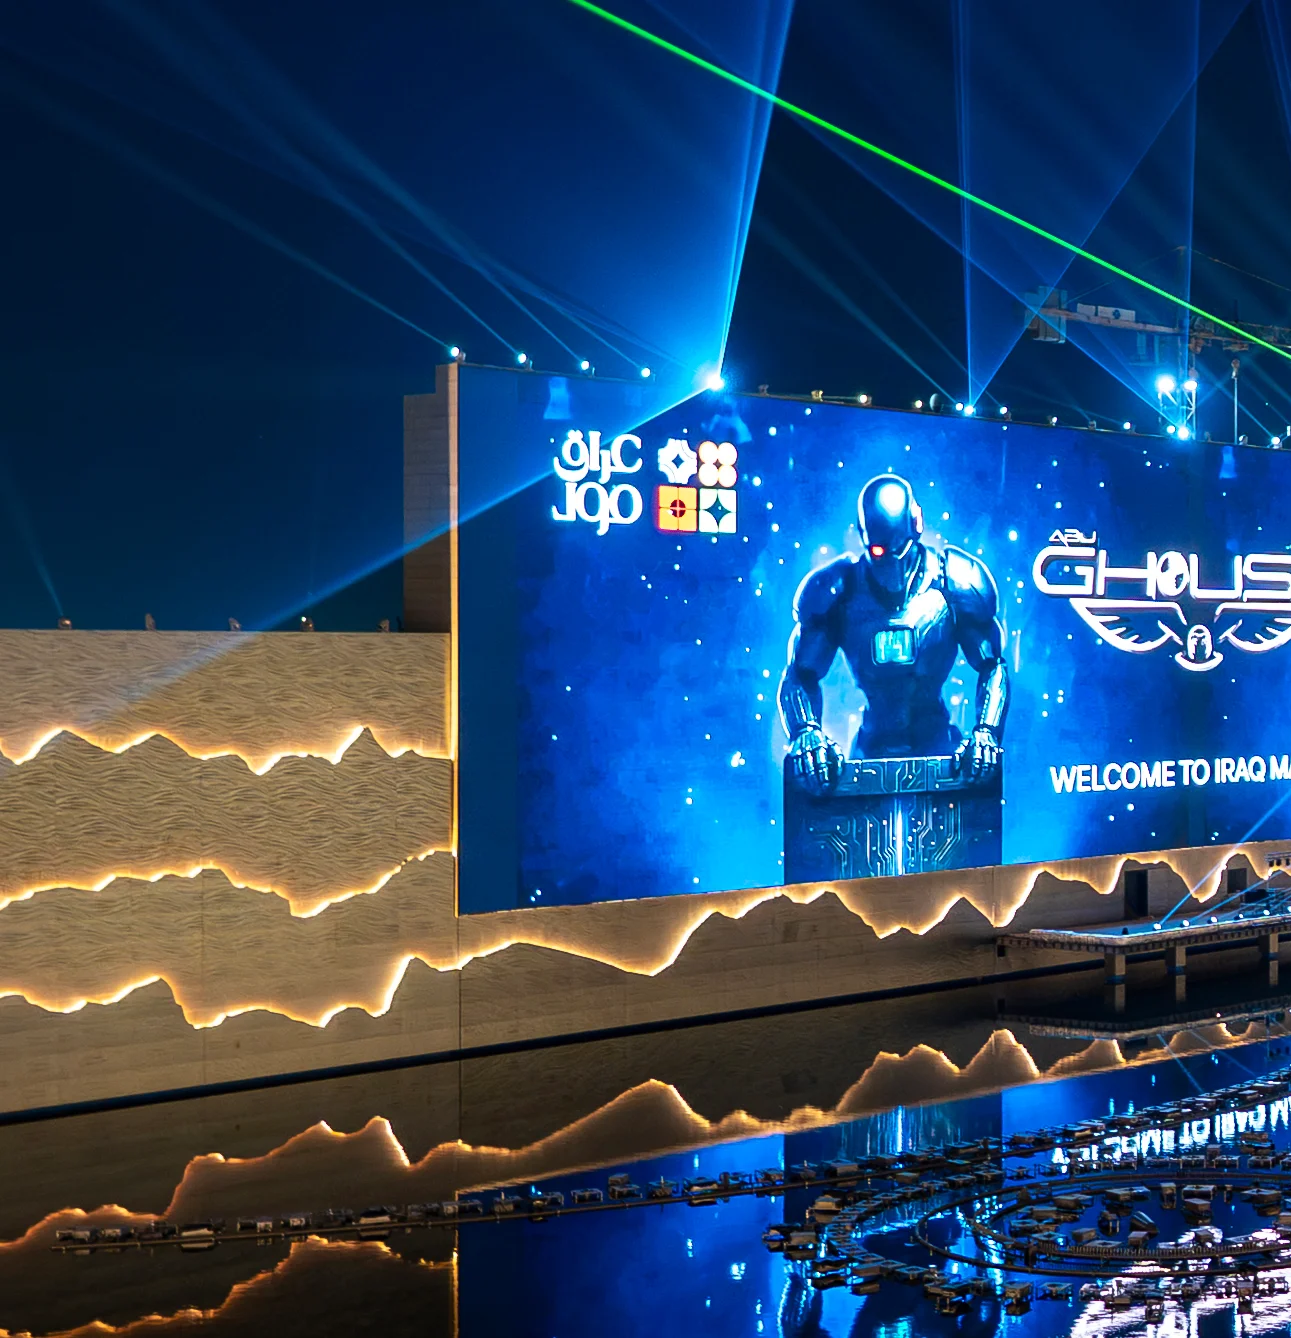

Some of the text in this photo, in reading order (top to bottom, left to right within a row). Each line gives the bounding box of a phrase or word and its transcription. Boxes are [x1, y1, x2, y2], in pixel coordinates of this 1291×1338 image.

[553, 429, 643, 484] عراق
[551, 481, 643, 536] مول
[1048, 529, 1097, 546] ABU
[1050, 761, 1176, 793] WELCOME
[1178, 758, 1211, 786] TO
[1214, 756, 1266, 783] IRAQ
